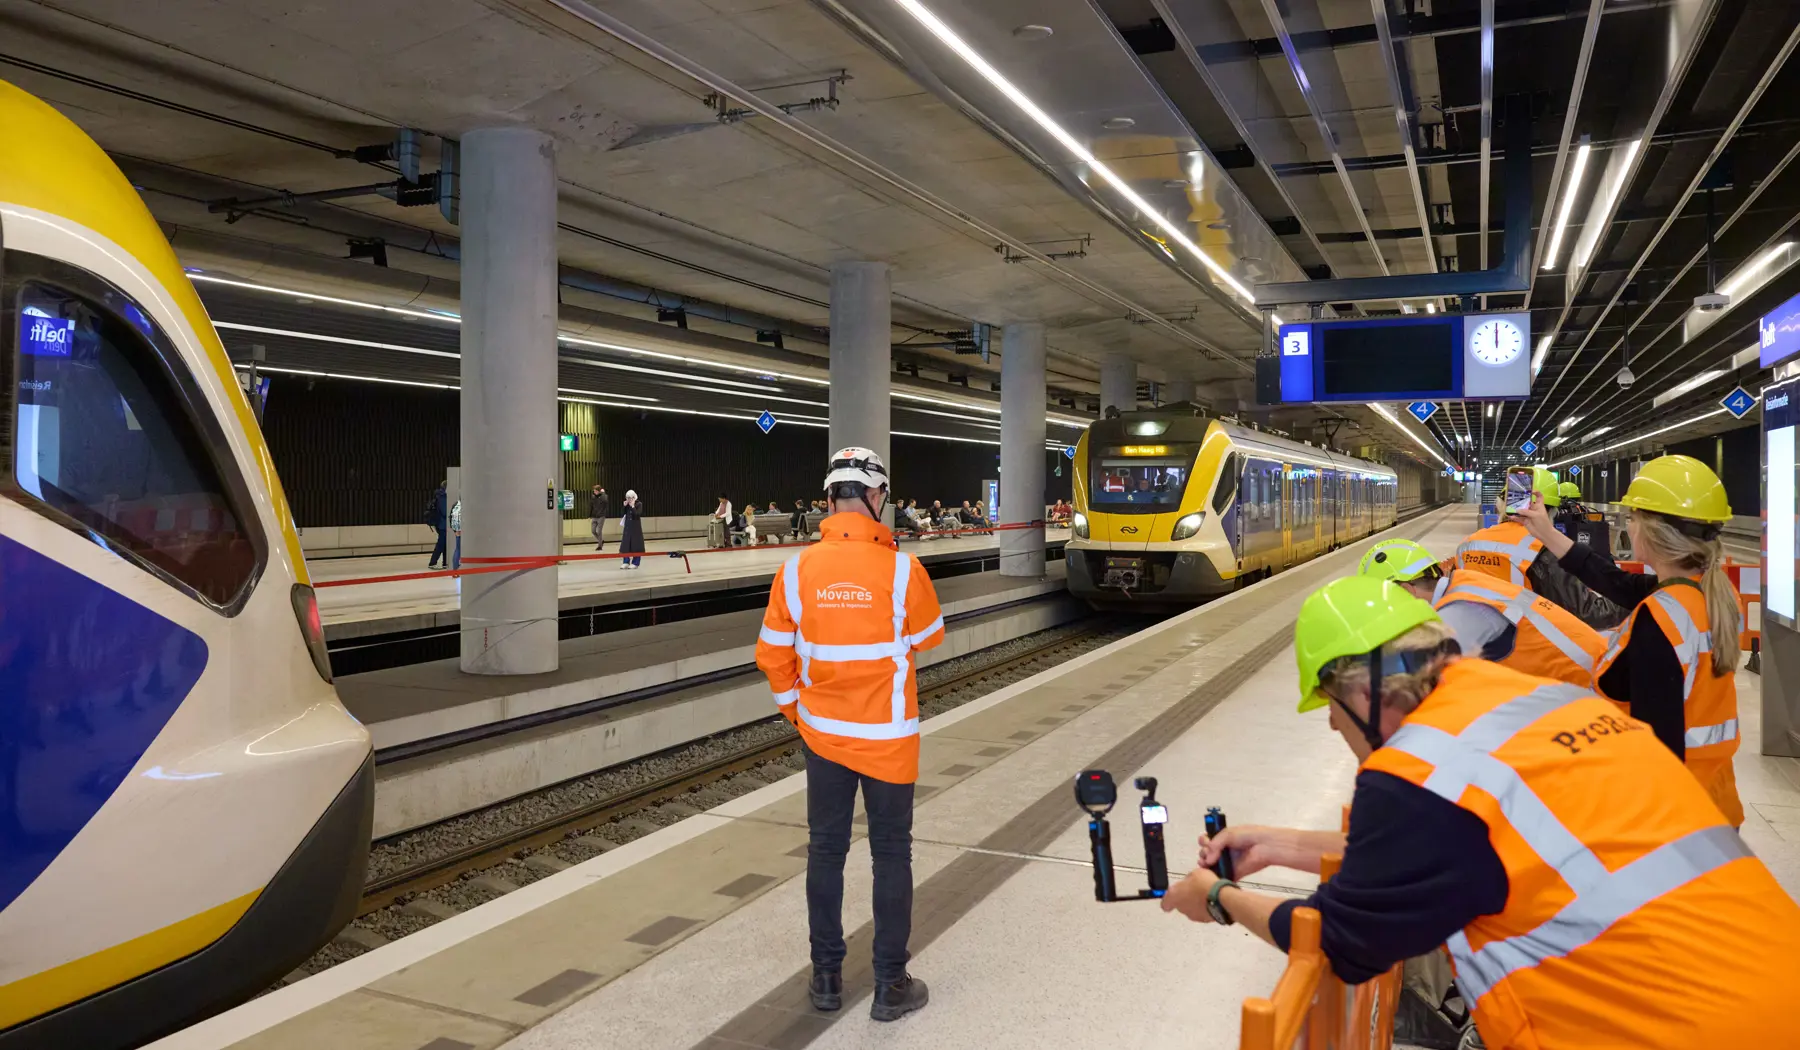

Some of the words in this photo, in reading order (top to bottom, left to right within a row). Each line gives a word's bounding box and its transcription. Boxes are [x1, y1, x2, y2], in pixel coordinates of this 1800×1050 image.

[1762, 322, 1776, 348] Delft
[1291, 340, 1301, 353] 3
[1416, 402, 1429, 414] 4
[1731, 395, 1746, 409] 4
[762, 416, 771, 427] 4
[1125, 446, 1138, 454] Den
[1465, 554, 1501, 566] ProRail
[816, 588, 873, 601] Movares
